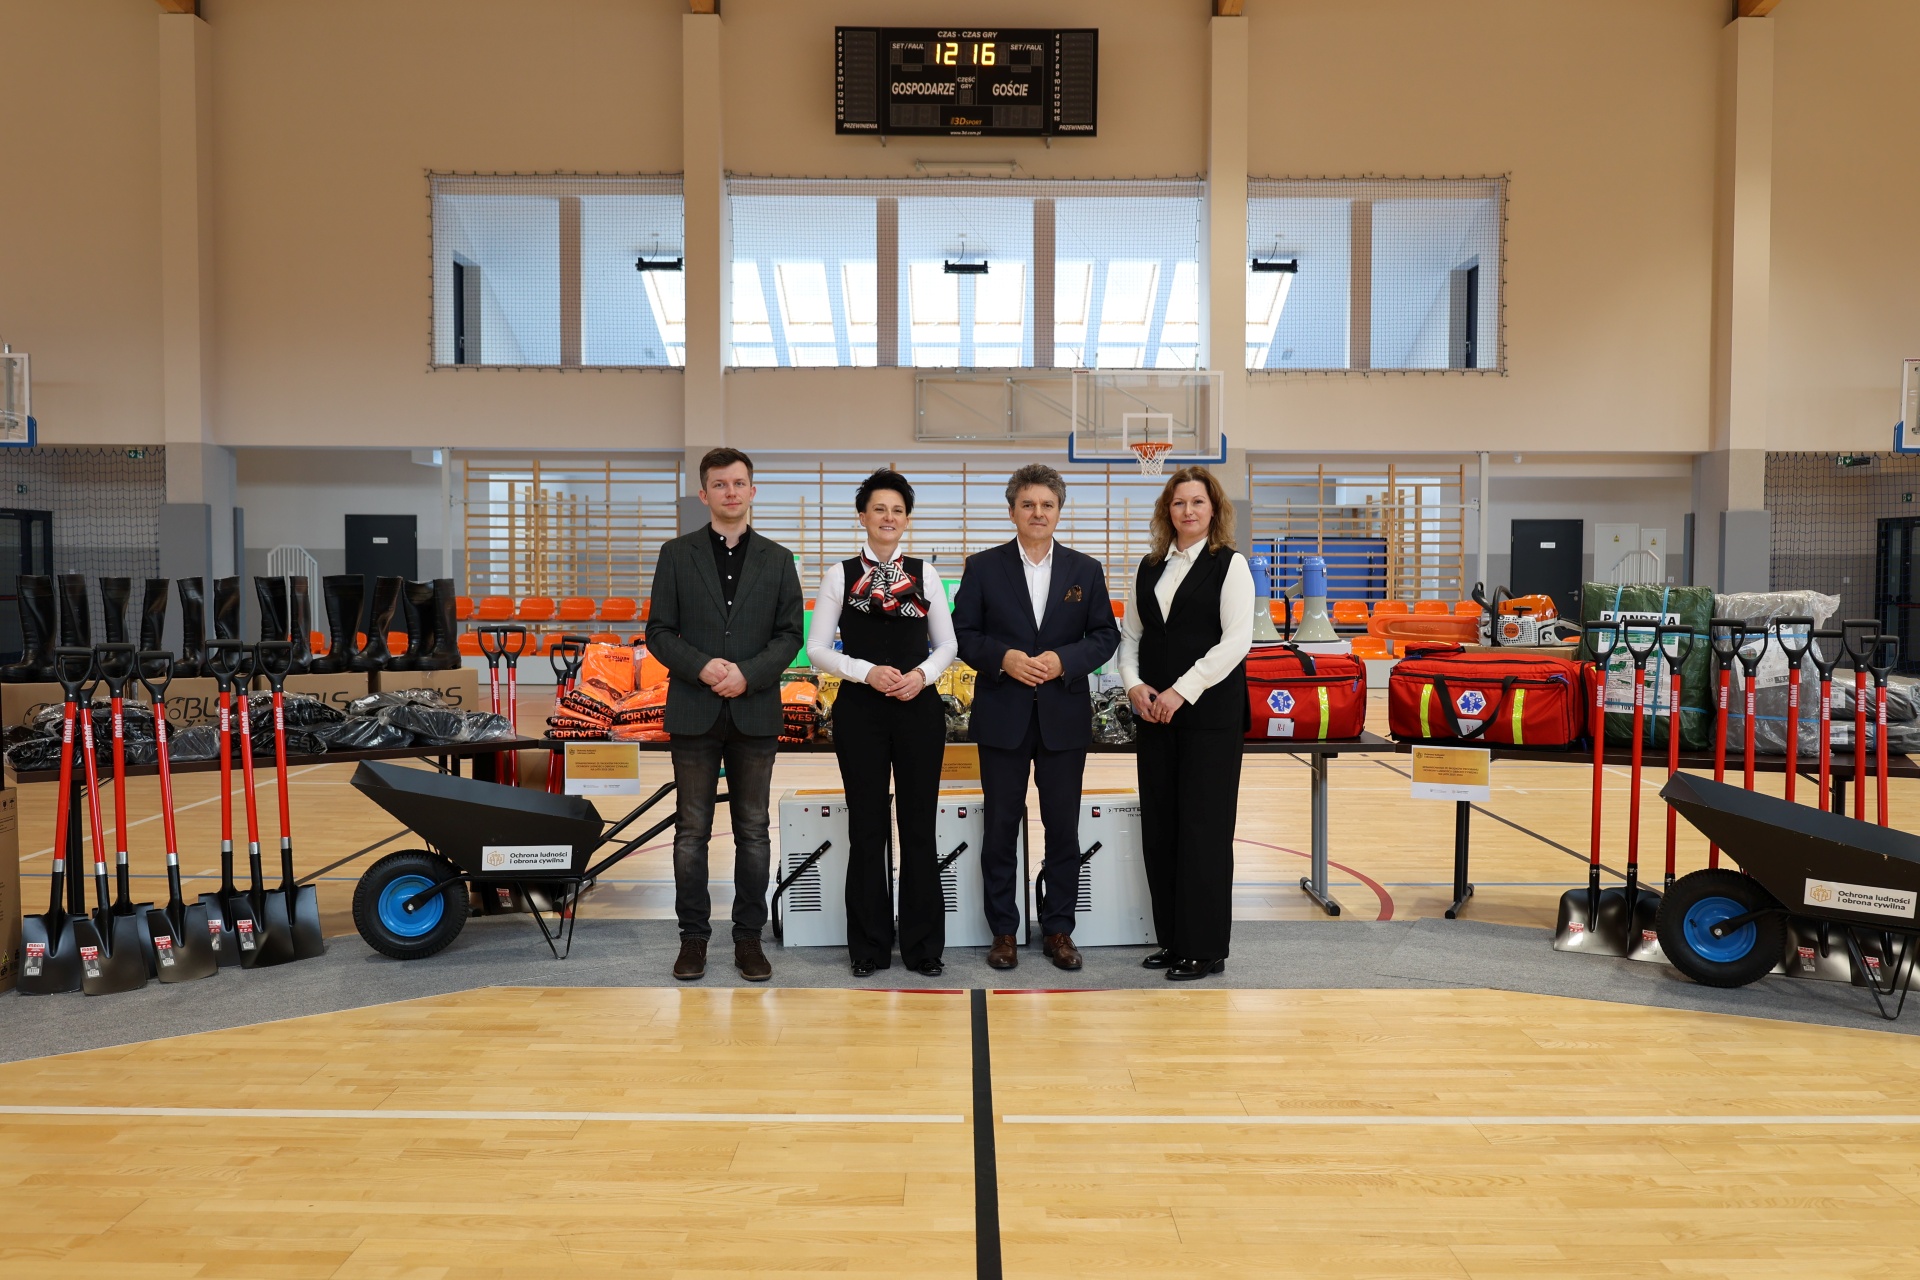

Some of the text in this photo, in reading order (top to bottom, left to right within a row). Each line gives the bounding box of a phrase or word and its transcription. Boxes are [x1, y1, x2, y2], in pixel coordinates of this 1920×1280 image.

[982, 31, 998, 39] GRY
[935, 42, 995, 66] 12 16
[891, 82, 955, 95] GOSPODARZE
[992, 80, 1029, 96] GOŚCIE
[549, 730, 609, 739] PORTWEST
[1838, 890, 1911, 905] Ochrona ludności
[1842, 898, 1872, 907] obrona
[1873, 902, 1906, 911] cywilna
